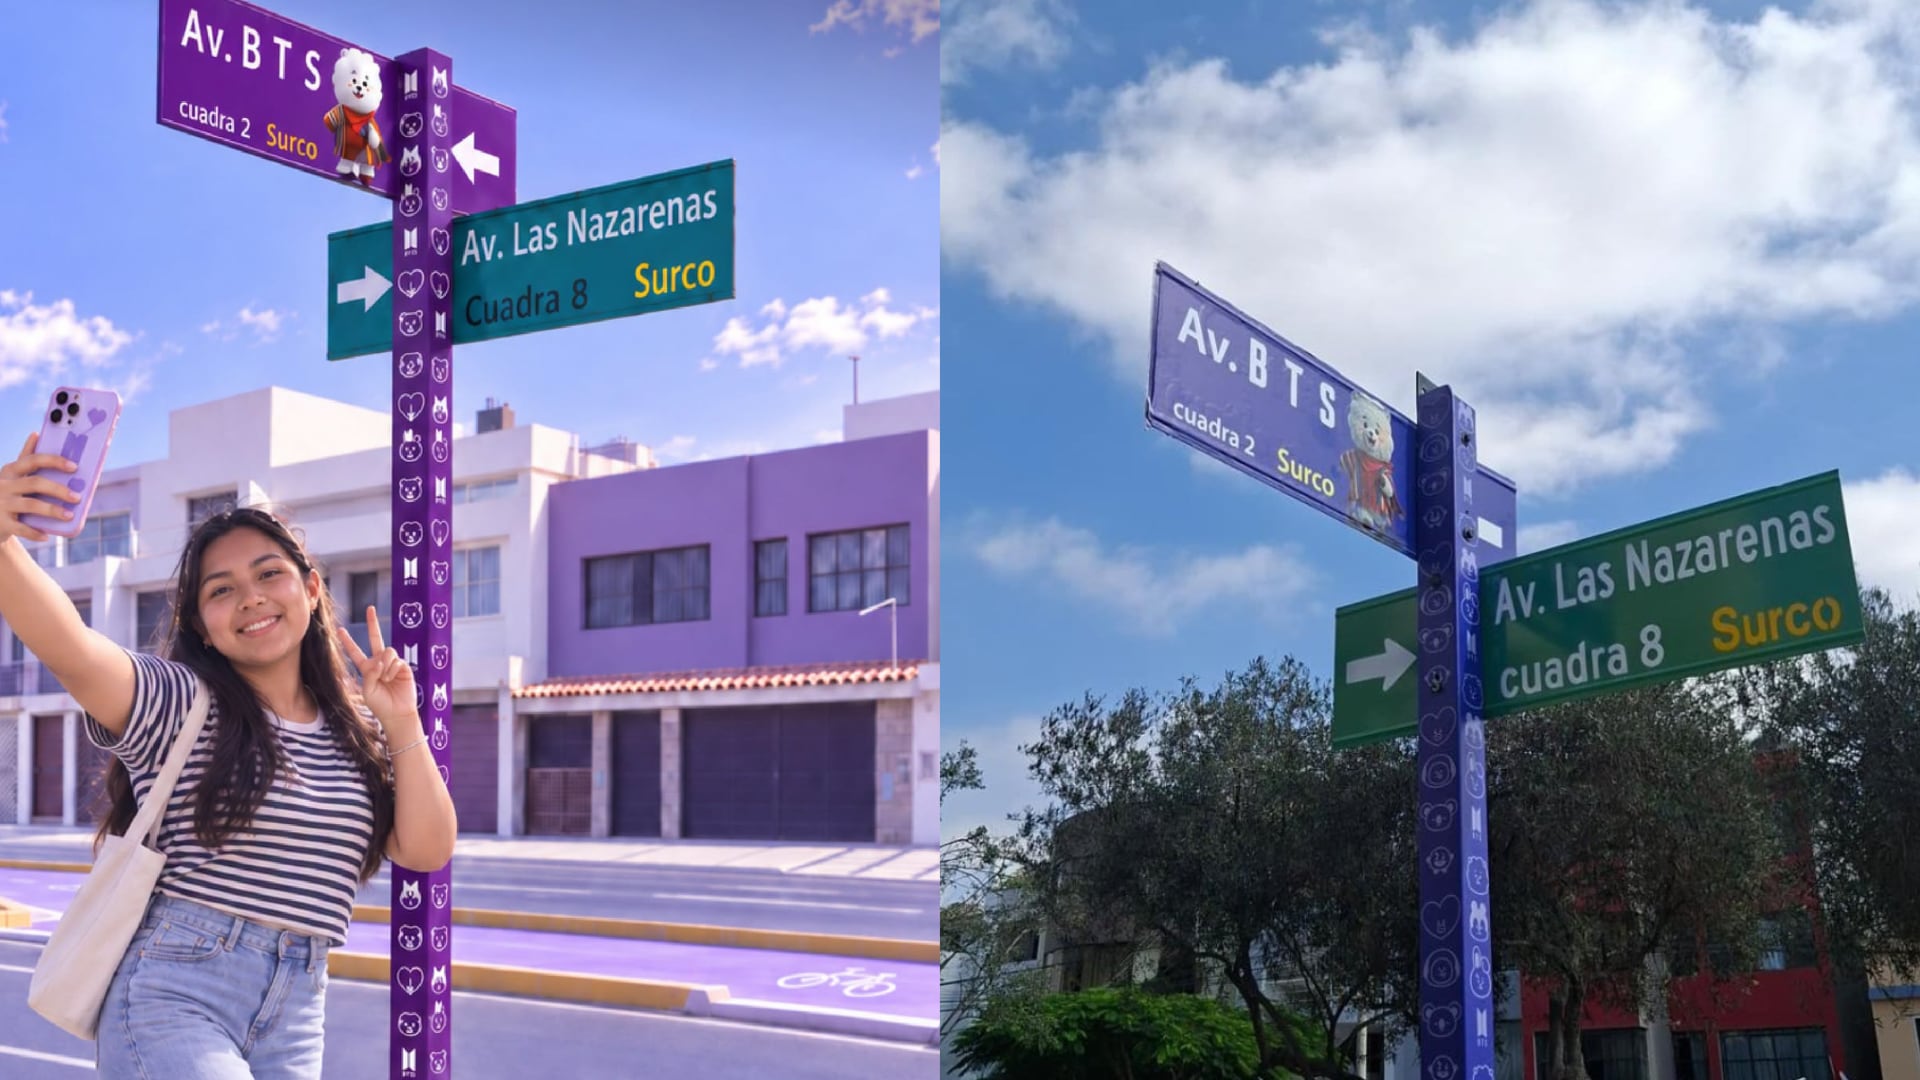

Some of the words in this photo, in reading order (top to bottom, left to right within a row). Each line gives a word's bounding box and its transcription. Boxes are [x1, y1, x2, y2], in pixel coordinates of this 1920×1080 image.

[180, 8, 232, 63] Av.
[179, 100, 235, 133] cuadra
[240, 117, 251, 139] 2
[266, 123, 318, 161] Surco
[461, 229, 504, 266] Av.
[513, 221, 558, 256] Las
[567, 189, 718, 246] Nazarenas
[465, 284, 560, 326] Cuadra
[571, 278, 588, 310] 8
[634, 260, 715, 299] Surco
[1177, 306, 1238, 373] Av.
[1173, 401, 1240, 449] cuadra
[1243, 435, 1256, 457] 2
[1276, 447, 1335, 498] Surco
[1494, 577, 1546, 625] Av.
[1555, 561, 1616, 609] Las
[1625, 504, 1836, 592] Nazarenas
[1500, 640, 1629, 699] cuadra
[1639, 623, 1665, 668] 8
[1711, 595, 1842, 651] Surco
